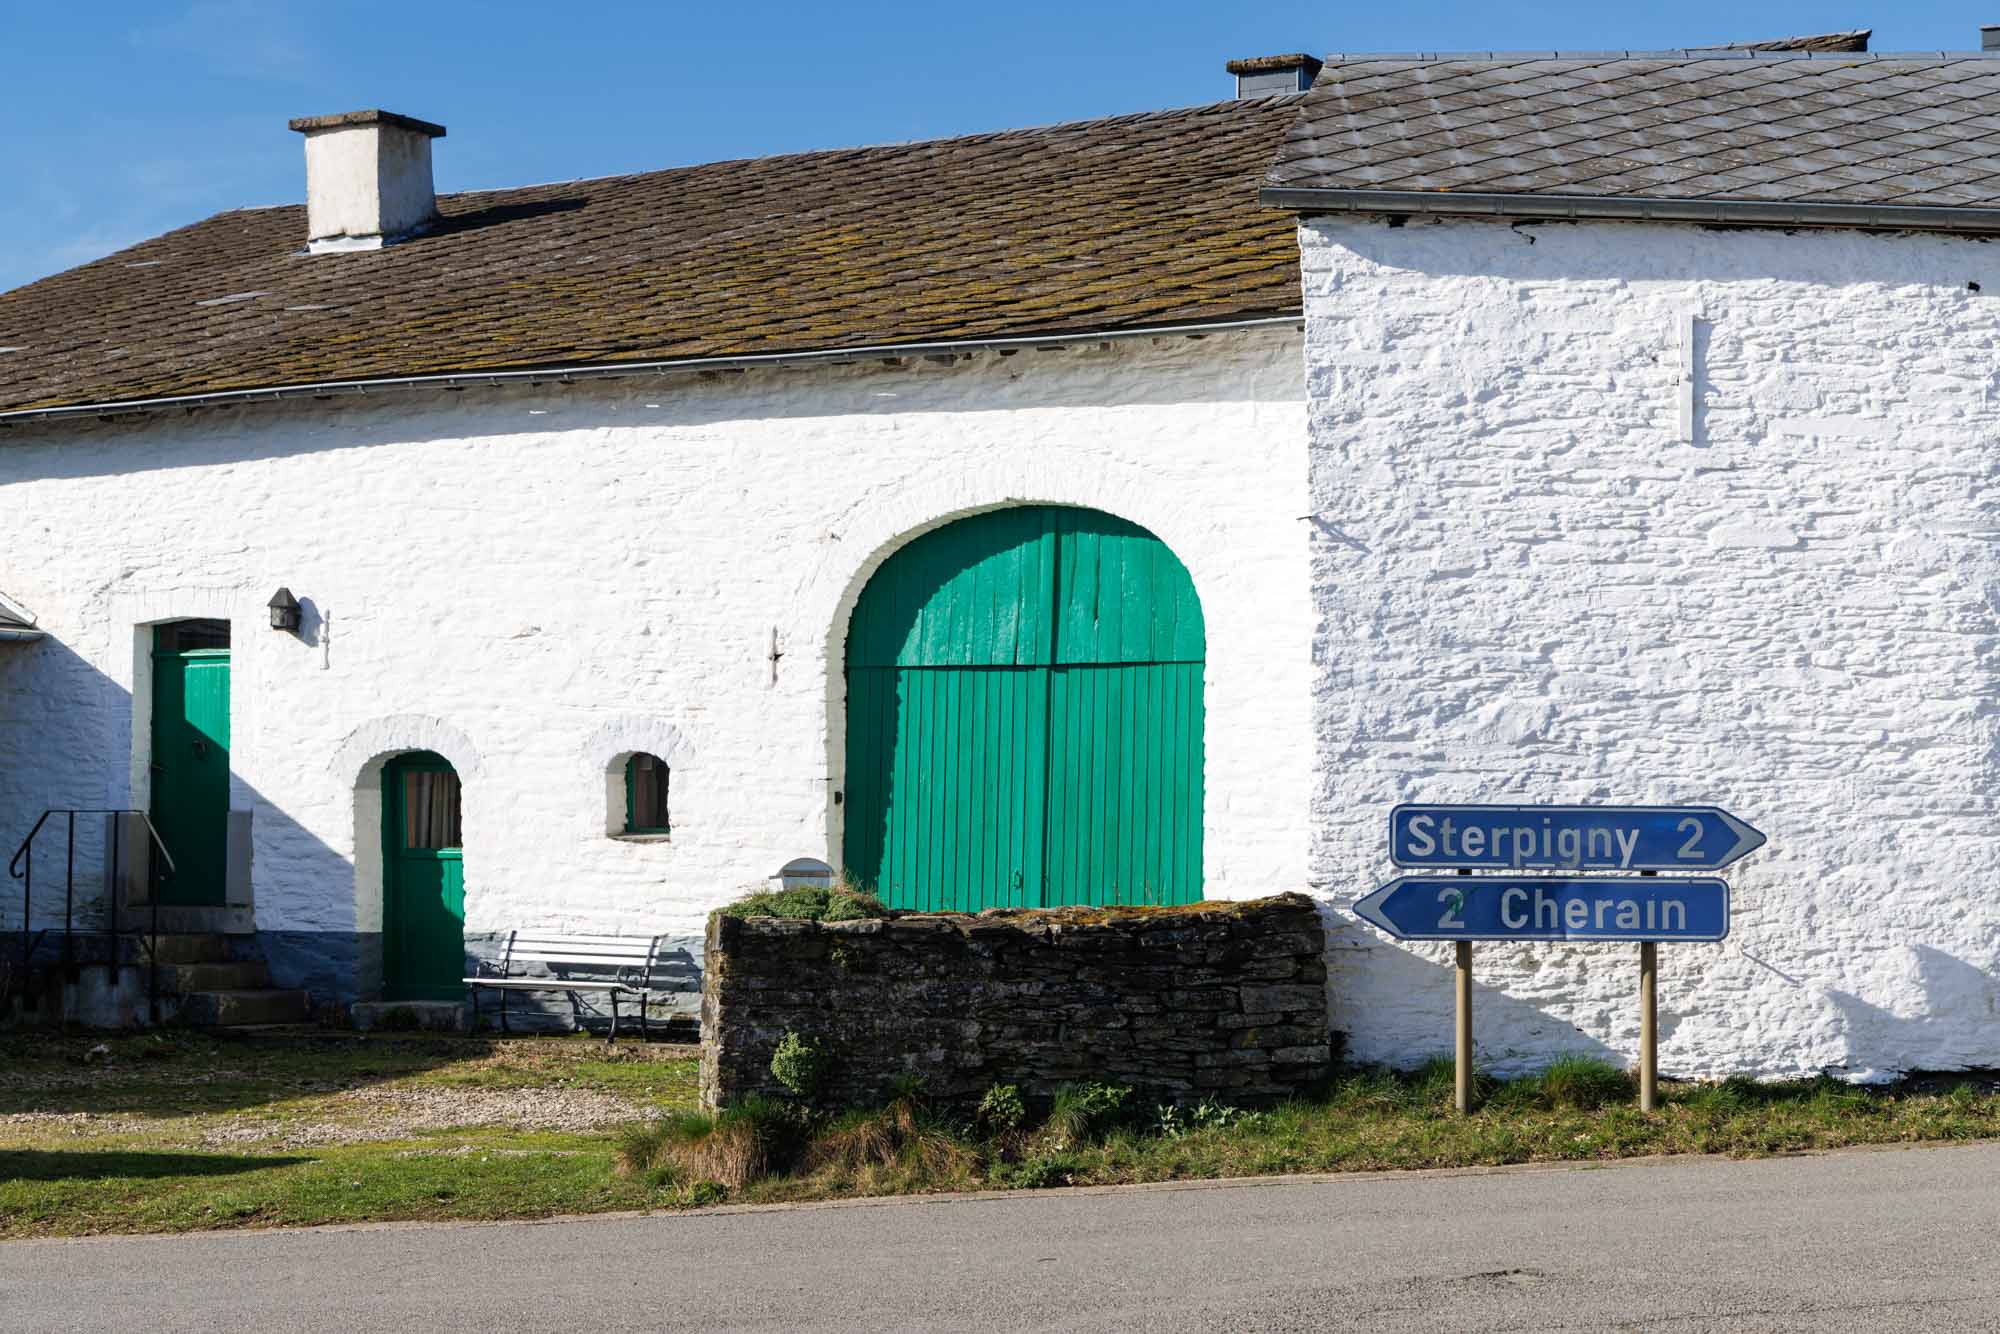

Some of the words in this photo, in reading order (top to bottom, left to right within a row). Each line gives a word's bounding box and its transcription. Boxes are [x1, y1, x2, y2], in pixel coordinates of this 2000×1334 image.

[1407, 815, 1640, 869] Sterpigny
[1677, 818, 1705, 859] 2
[1437, 888, 1465, 929] 2
[1501, 888, 1687, 930] Cherain
